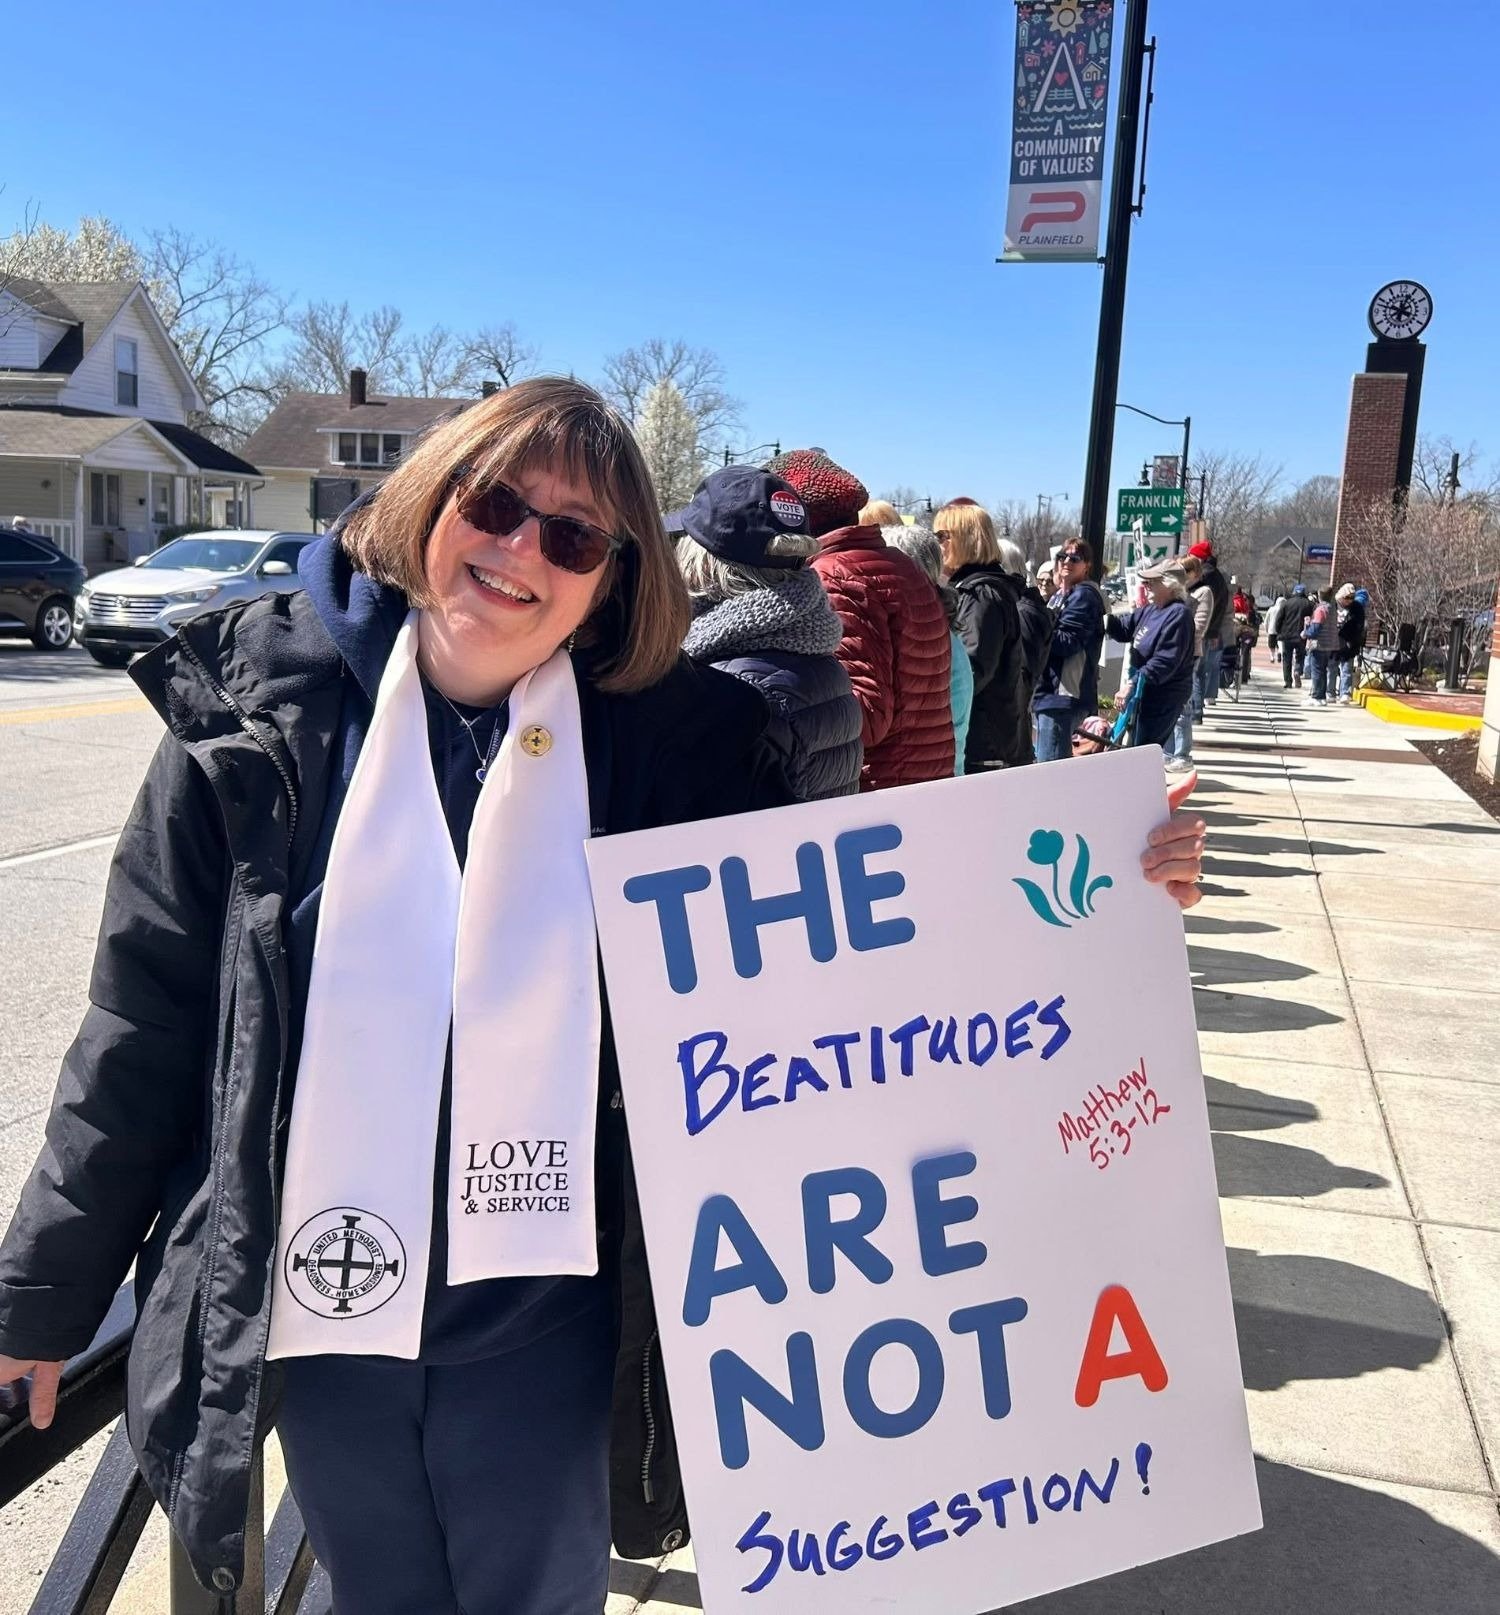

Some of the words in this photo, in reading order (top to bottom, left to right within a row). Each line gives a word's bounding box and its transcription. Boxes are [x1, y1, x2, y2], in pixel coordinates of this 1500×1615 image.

[1053, 119, 1064, 136] A
[1014, 136, 1102, 157] COMMUNITY
[1019, 160, 1037, 176] OF
[1041, 156, 1094, 176] VALUES
[1018, 235, 1084, 245] PLAINFIELD
[776, 503, 801, 514] VOTE
[1120, 495, 1181, 508] FRANKLIN
[623, 824, 916, 995] THE
[677, 995, 1072, 1138] BEATITUDES
[1058, 1057, 1147, 1154] Matthew
[1089, 1088, 1171, 1170] 5:3-12
[465, 1140, 569, 1171] LOVE
[460, 1172, 569, 1200] JUSTICE
[464, 1199, 479, 1214] &
[487, 1196, 570, 1213] SERVICE
[313, 1232, 338, 1255] UNITED
[343, 1229, 382, 1257] METHODIST
[683, 1151, 988, 1327] ARE
[308, 1259, 332, 1295] DEACONESS
[336, 1288, 360, 1298] HOME
[709, 1296, 1029, 1470] NOT
[1074, 1284, 1169, 1408] A
